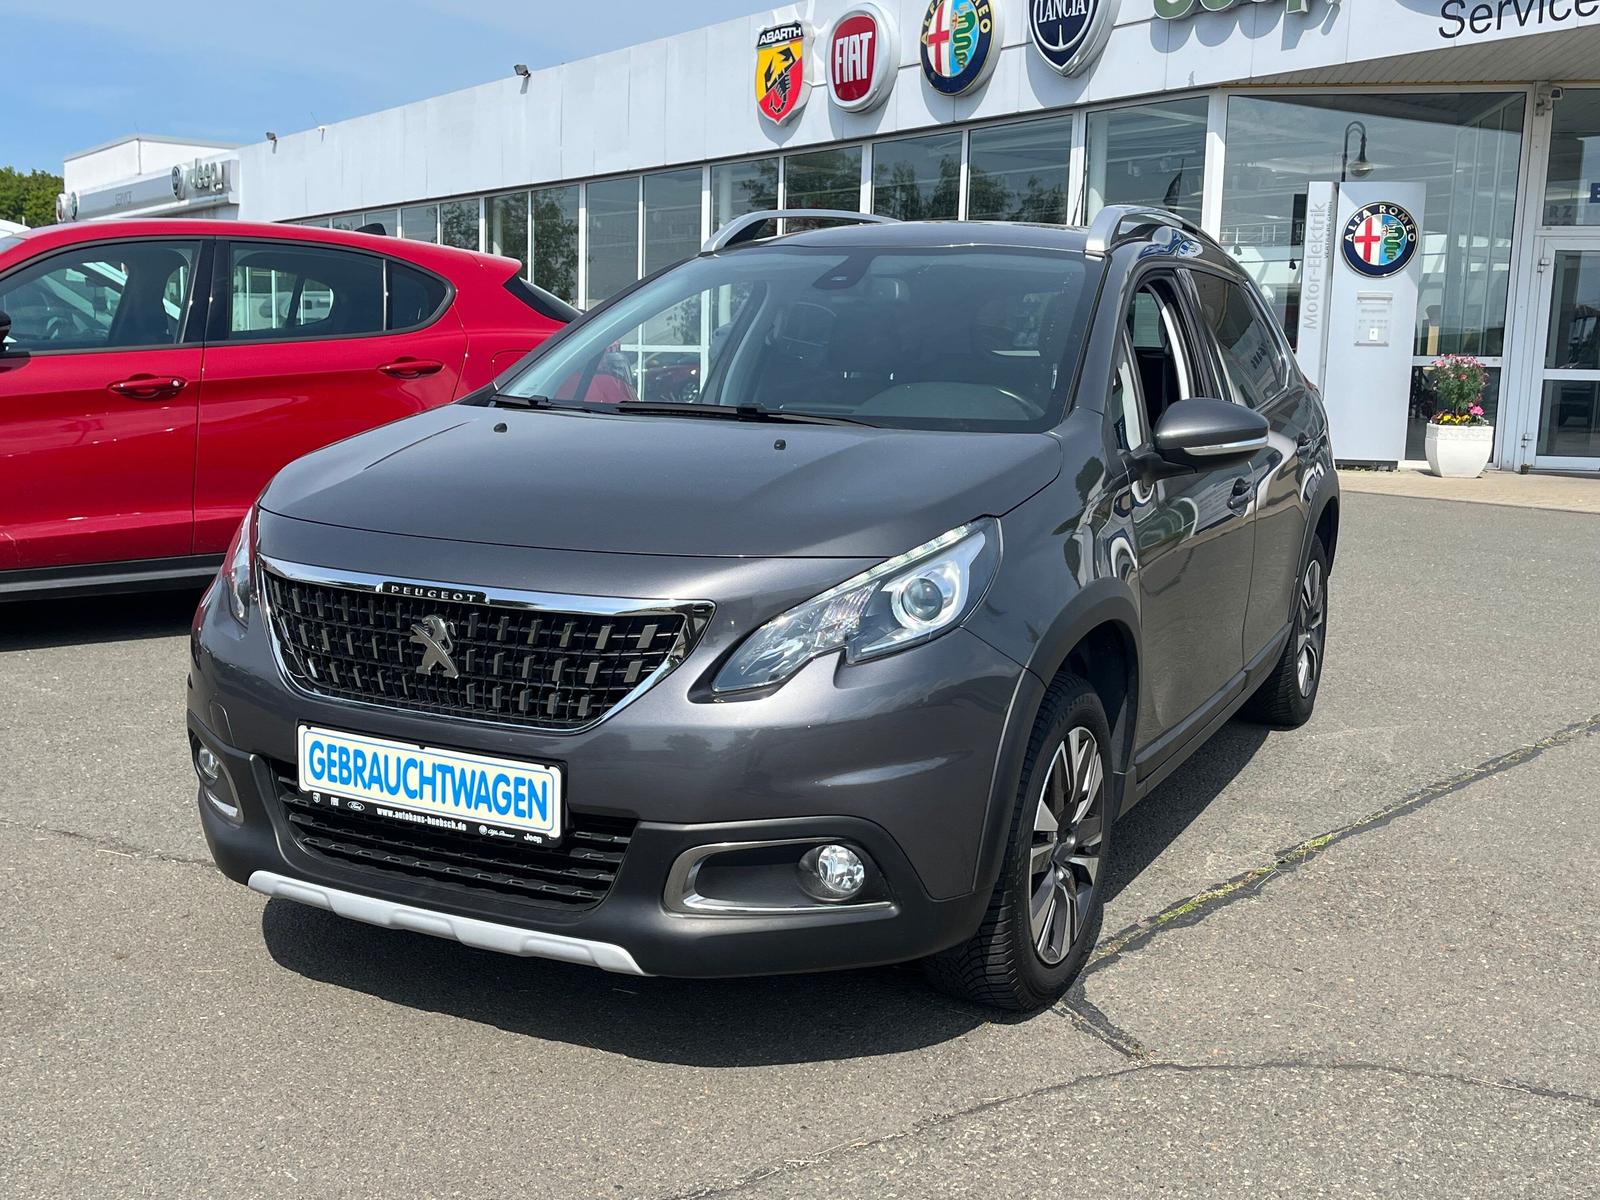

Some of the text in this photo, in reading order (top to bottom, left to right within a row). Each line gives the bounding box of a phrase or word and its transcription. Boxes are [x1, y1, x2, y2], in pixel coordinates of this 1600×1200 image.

[760, 27, 801, 45] ABARTH
[835, 32, 872, 84] FIAT
[190, 158, 224, 192] Jeep
[1345, 205, 1416, 242] ALFA ROMEO
[1303, 202, 1326, 330] Motor-Elektrik
[391, 585, 476, 602] PEUGEOT
[309, 740, 547, 822] GEBRAUCHTWAGEN
